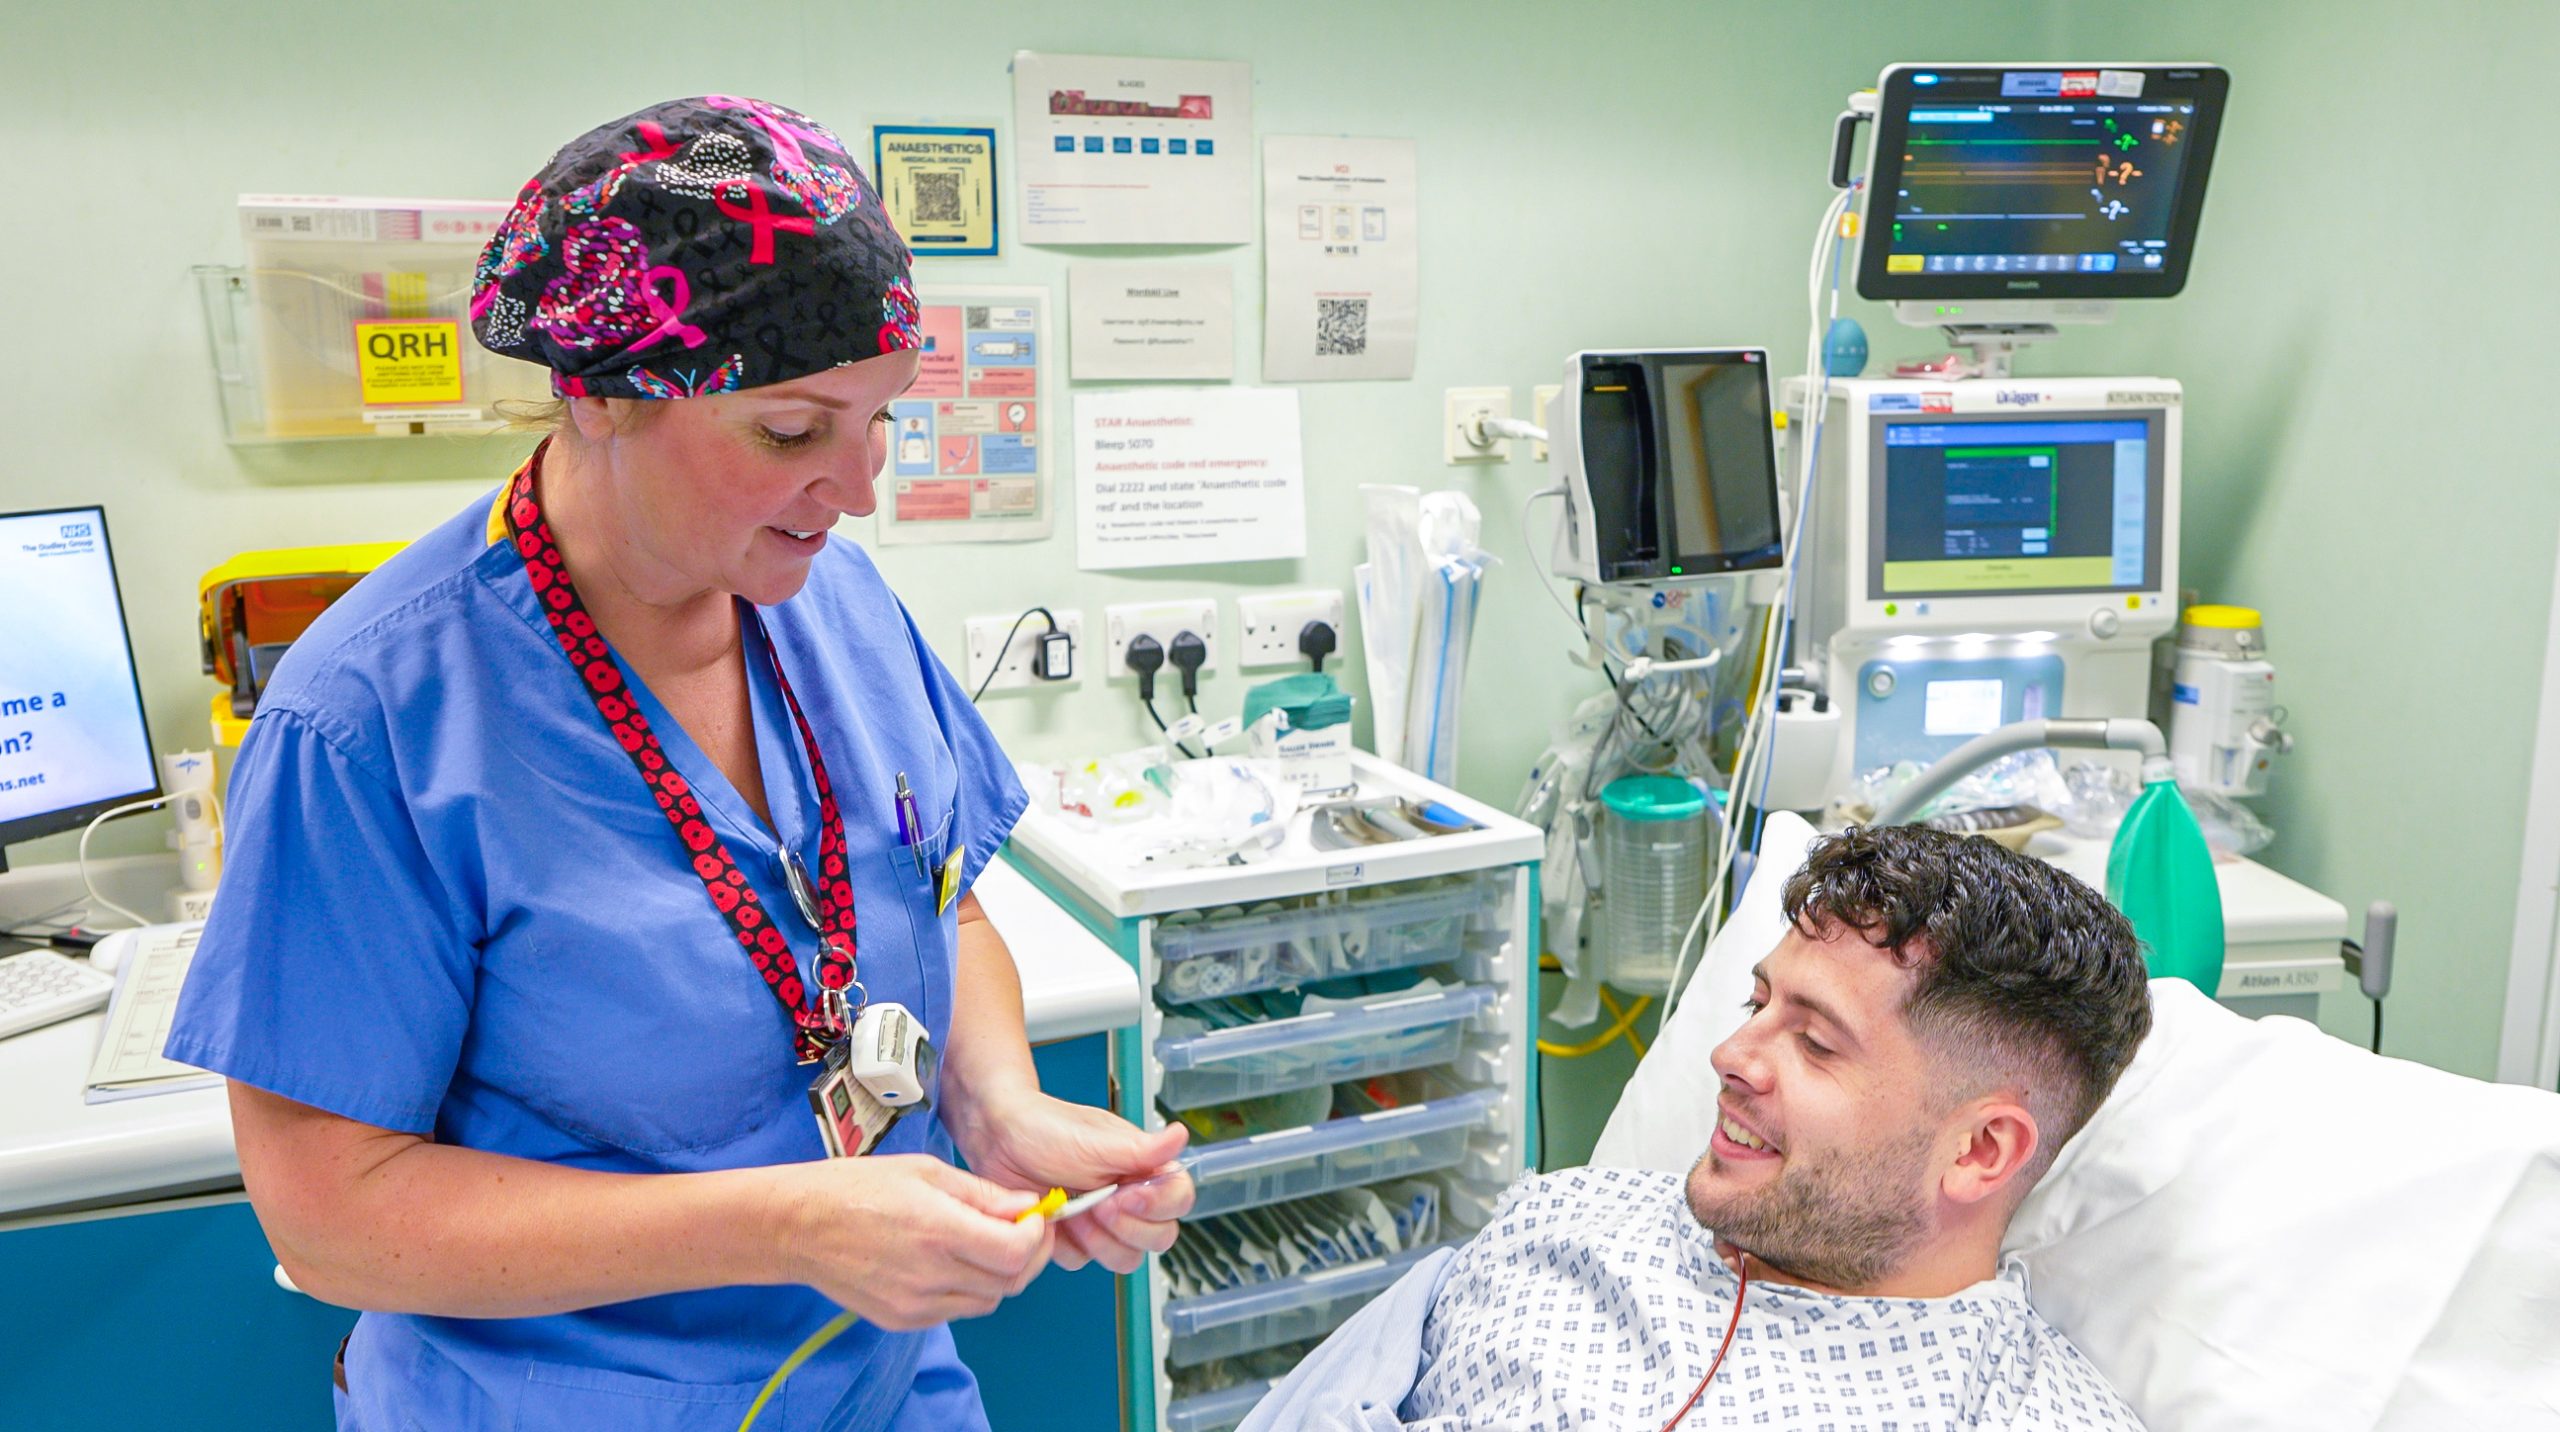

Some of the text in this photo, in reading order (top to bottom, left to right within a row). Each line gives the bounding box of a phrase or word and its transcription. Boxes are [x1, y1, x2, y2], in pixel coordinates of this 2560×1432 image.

[887, 142, 984, 154] ANAESTHETICS
[368, 332, 447, 361] QRH
[1094, 417, 1122, 428] STAR
[1095, 438, 1153, 451] Bleep 5070
[1095, 460, 1158, 472] Anaesthetic
[1161, 459, 1185, 470] code
[1188, 459, 1206, 469] red
[1096, 482, 1116, 493] Dial
[1119, 482, 1145, 493] 2222
[1148, 481, 1167, 492] and
[1170, 481, 1195, 491] state
[1263, 478, 1287, 488] code
[1120, 501, 1141, 512] and
[1143, 501, 1159, 511] the
[1162, 499, 1203, 510] location
[61, 523, 91, 538] NHS
[1, 691, 66, 716] me a
[0, 730, 33, 756] n?
[2241, 974, 2280, 988] Atlan
